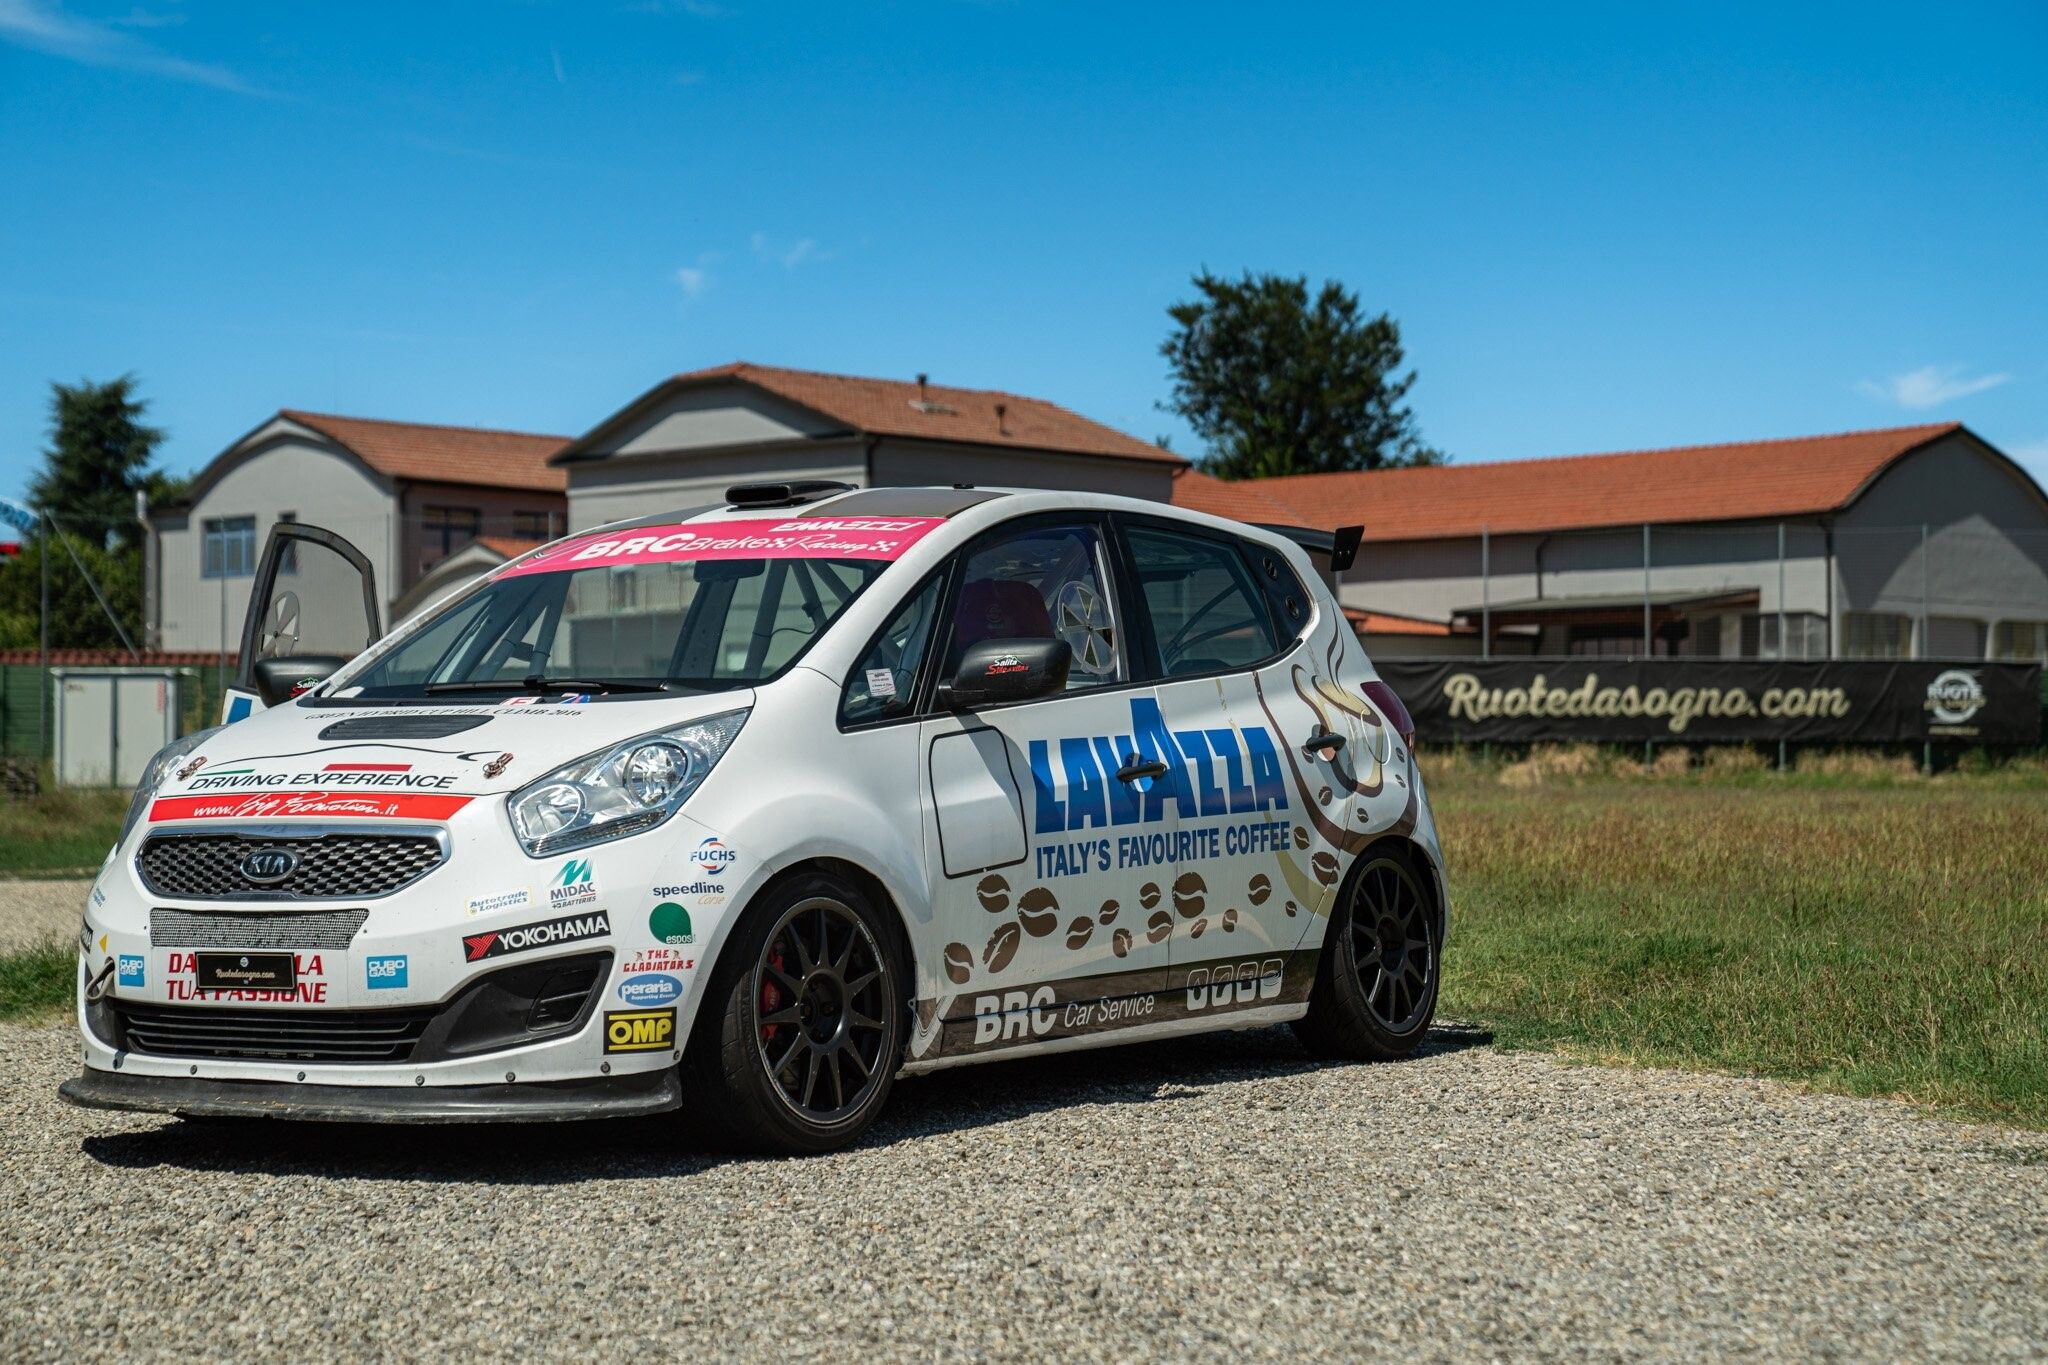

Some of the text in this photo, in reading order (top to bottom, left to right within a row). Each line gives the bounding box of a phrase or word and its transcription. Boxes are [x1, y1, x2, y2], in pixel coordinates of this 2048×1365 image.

[569, 533, 868, 561] BRC Brake Racing
[1443, 672, 1851, 733] Ruotedasogno.com
[1028, 697, 1289, 834] LAVAZZA
[187, 773, 458, 791] DRIVING EXPERIENCE
[690, 850, 736, 862] FUCHS
[1036, 821, 1291, 879] ITALY'S FAVOURITE COFFEE
[251, 855, 285, 874] KIA
[469, 890, 528, 908] Autotrade
[550, 882, 596, 900] MIDAC
[652, 882, 725, 898] speedline
[479, 897, 528, 912] Logistics
[562, 896, 596, 908] BATTERIES
[497, 915, 610, 950] YOKOHAMA
[647, 949, 669, 960] THE
[368, 959, 406, 969] CUBO
[368, 968, 397, 978] GAS
[623, 960, 694, 972] GLADIATORS
[973, 985, 1058, 1045] BRC
[1064, 991, 1155, 1028] Car Service
[608, 1018, 672, 1044] OMP
